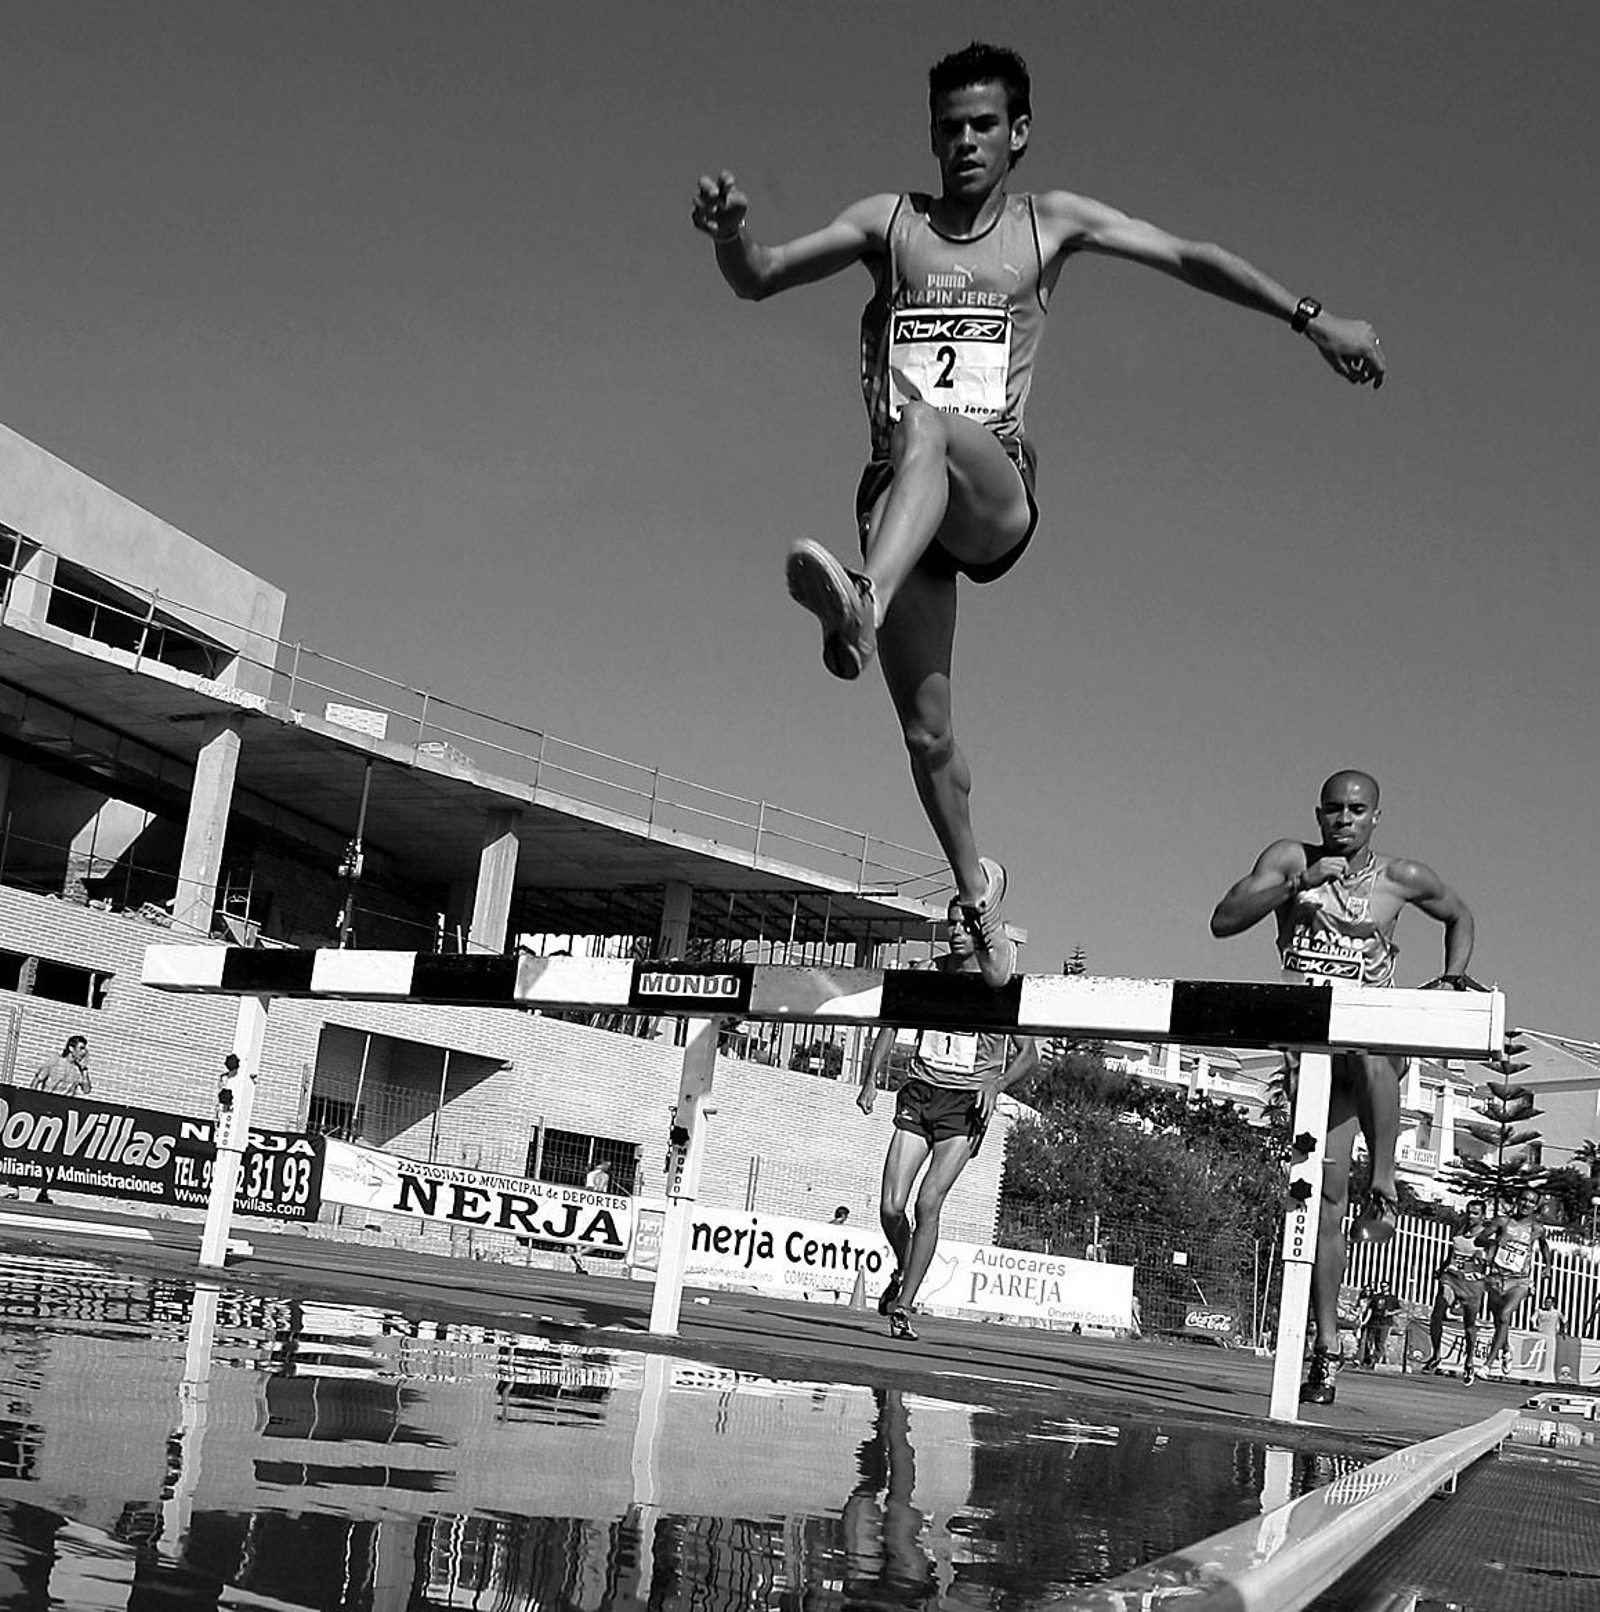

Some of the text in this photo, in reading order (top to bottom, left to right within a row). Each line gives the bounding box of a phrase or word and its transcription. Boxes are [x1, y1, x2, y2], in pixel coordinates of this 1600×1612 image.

[957, 290, 1008, 308] JEREZ
[934, 345, 957, 389] 2
[641, 973, 738, 995] MONDO
[945, 1035, 951, 1055] 1
[0, 1097, 177, 1169] onVillas
[180, 1121, 317, 1157] NRJA
[222, 1107, 233, 1146] ONDO
[0, 1157, 164, 1195] iliaria y Administraciones
[174, 1156, 199, 1187] TEL.
[246, 1152, 275, 1200] 31
[281, 1156, 311, 1205] 93
[397, 1160, 628, 1211] PATRONATO MUNICIPAL de DEPORTES
[673, 1147, 688, 1194] MONDO
[393, 1172, 624, 1246] NERJA
[691, 1217, 882, 1273] nerja Centro
[972, 1248, 1066, 1277] Autocares
[966, 1271, 1061, 1306] PAREJA
